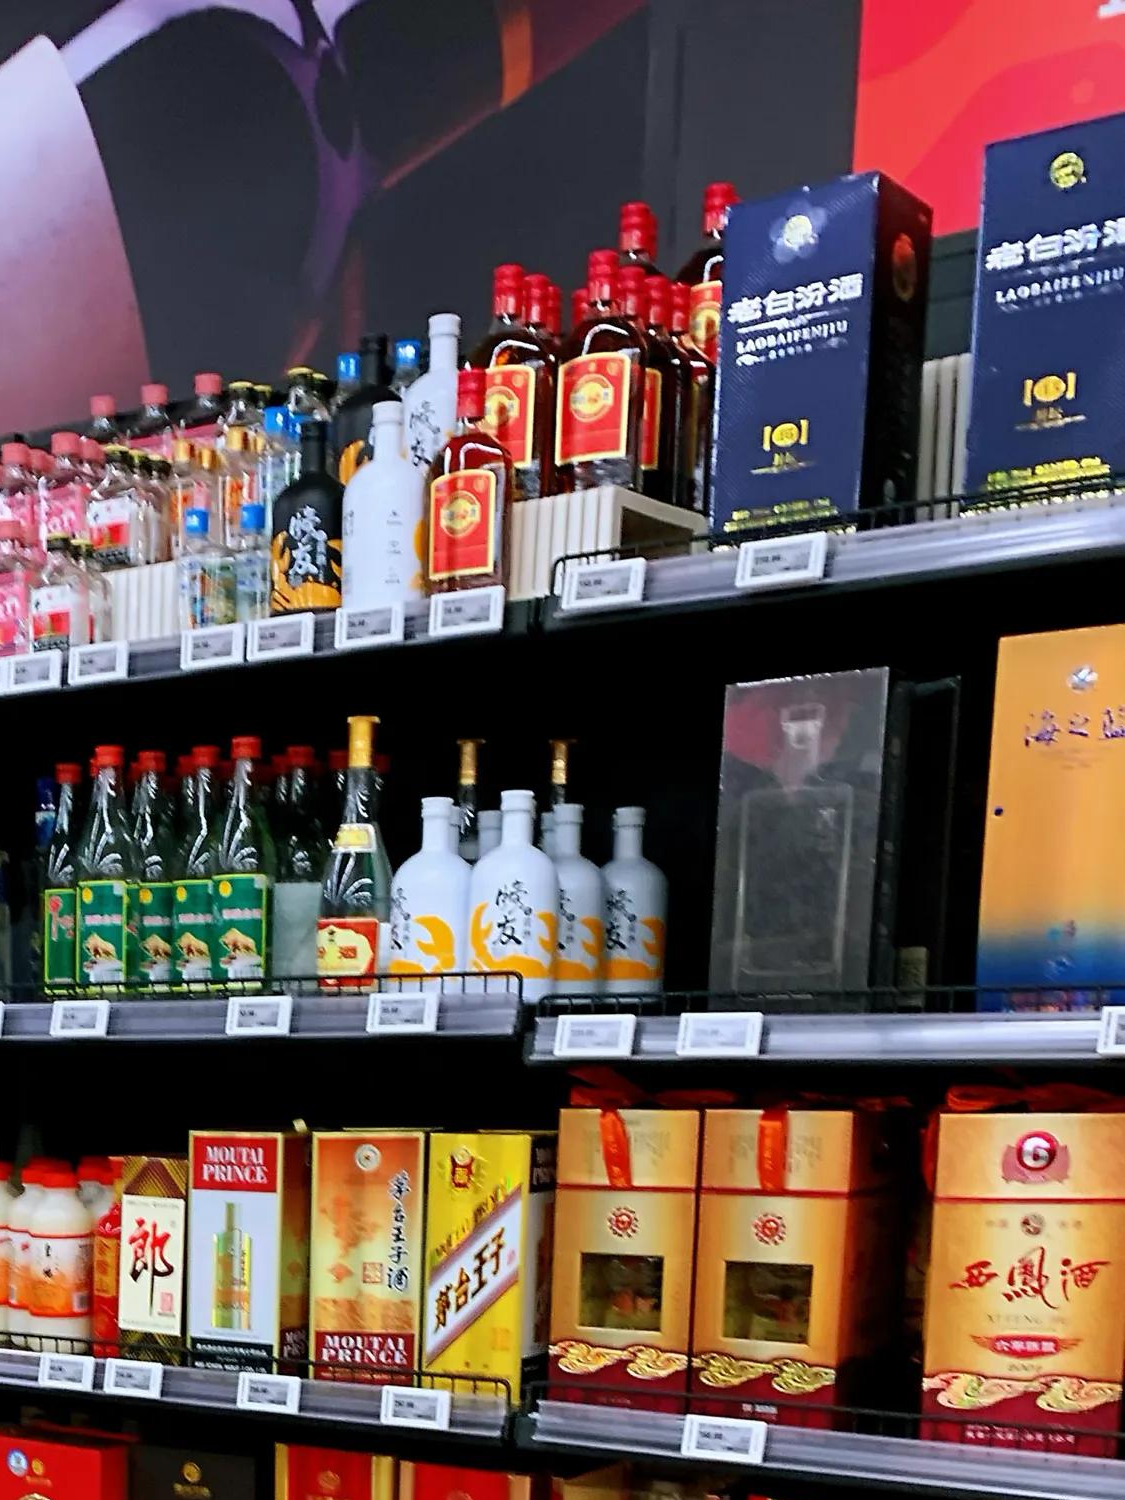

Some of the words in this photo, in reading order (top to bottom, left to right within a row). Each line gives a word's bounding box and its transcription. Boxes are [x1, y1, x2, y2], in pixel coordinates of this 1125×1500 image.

[727, 272, 864, 323] 老白汾酒
[206, 1145, 265, 1166] MOUTAI
[202, 1163, 268, 1184] PRINCE
[127, 1216, 175, 1317] 郎
[324, 1334, 408, 1353] MOUTAI
[321, 1347, 408, 1365] PRINCE
